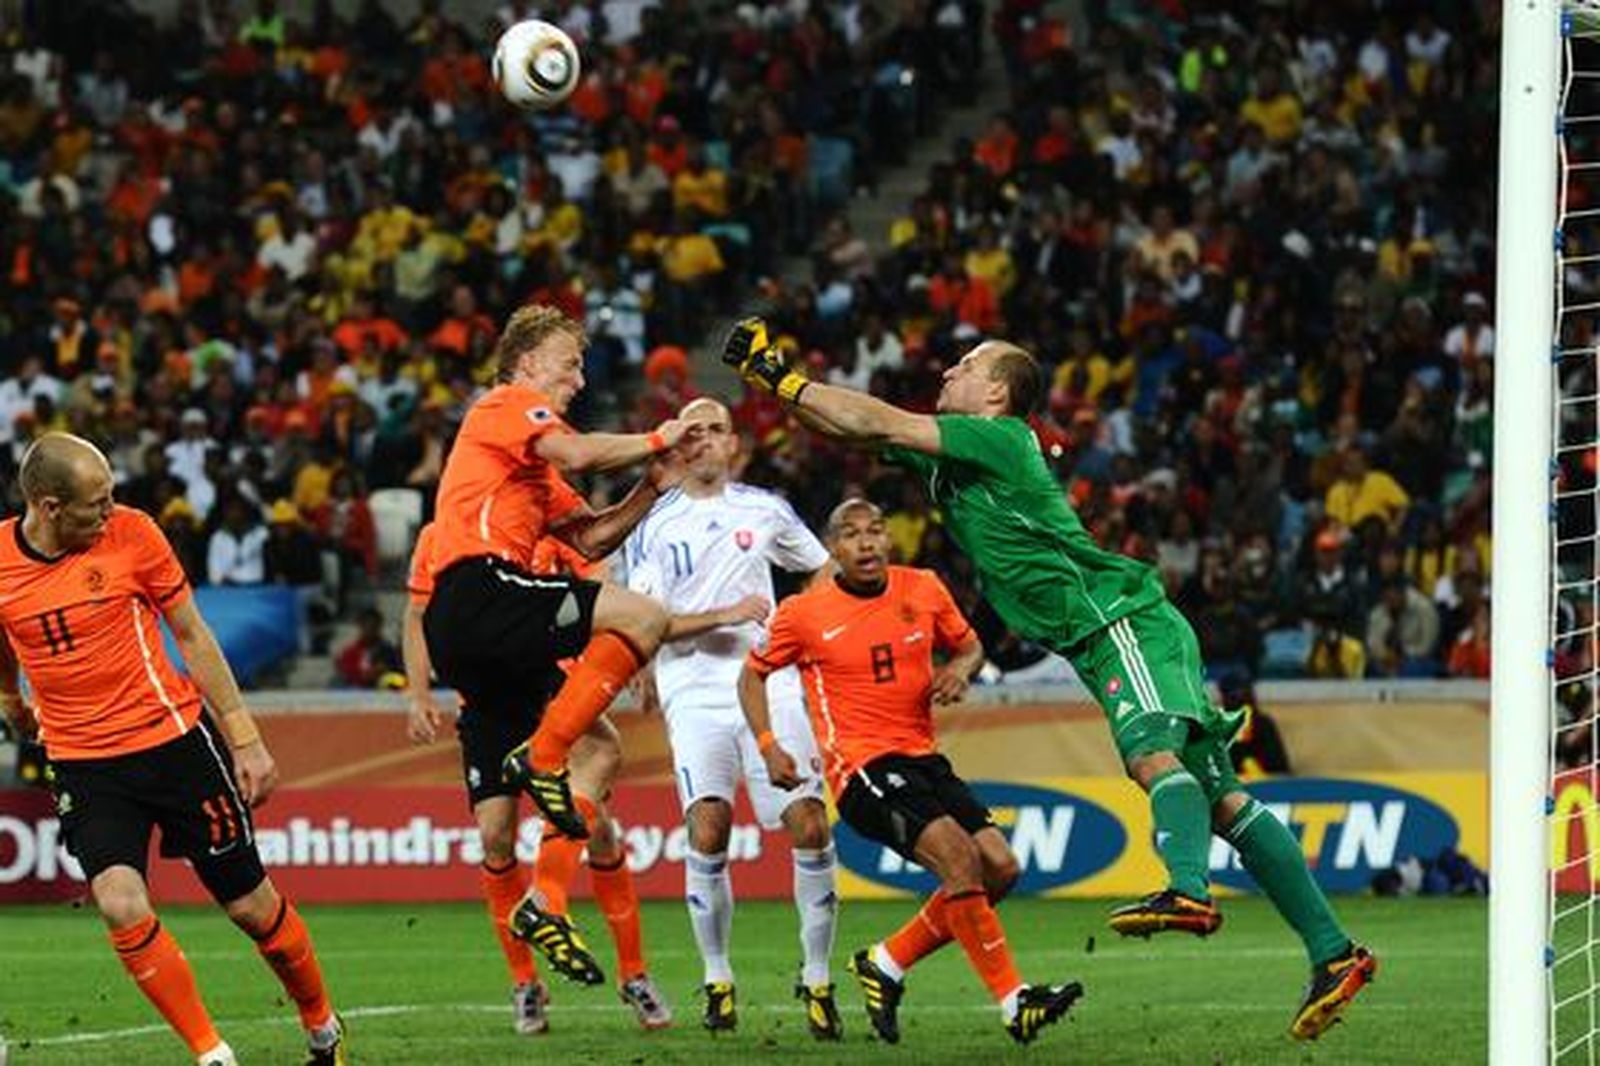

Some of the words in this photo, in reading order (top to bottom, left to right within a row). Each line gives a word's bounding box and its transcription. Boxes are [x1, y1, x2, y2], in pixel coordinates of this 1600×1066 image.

[667, 541, 693, 577] 11
[38, 607, 76, 655] 11
[870, 642, 897, 685] 8
[183, 816, 487, 867] ahindra
[202, 794, 237, 842] 11
